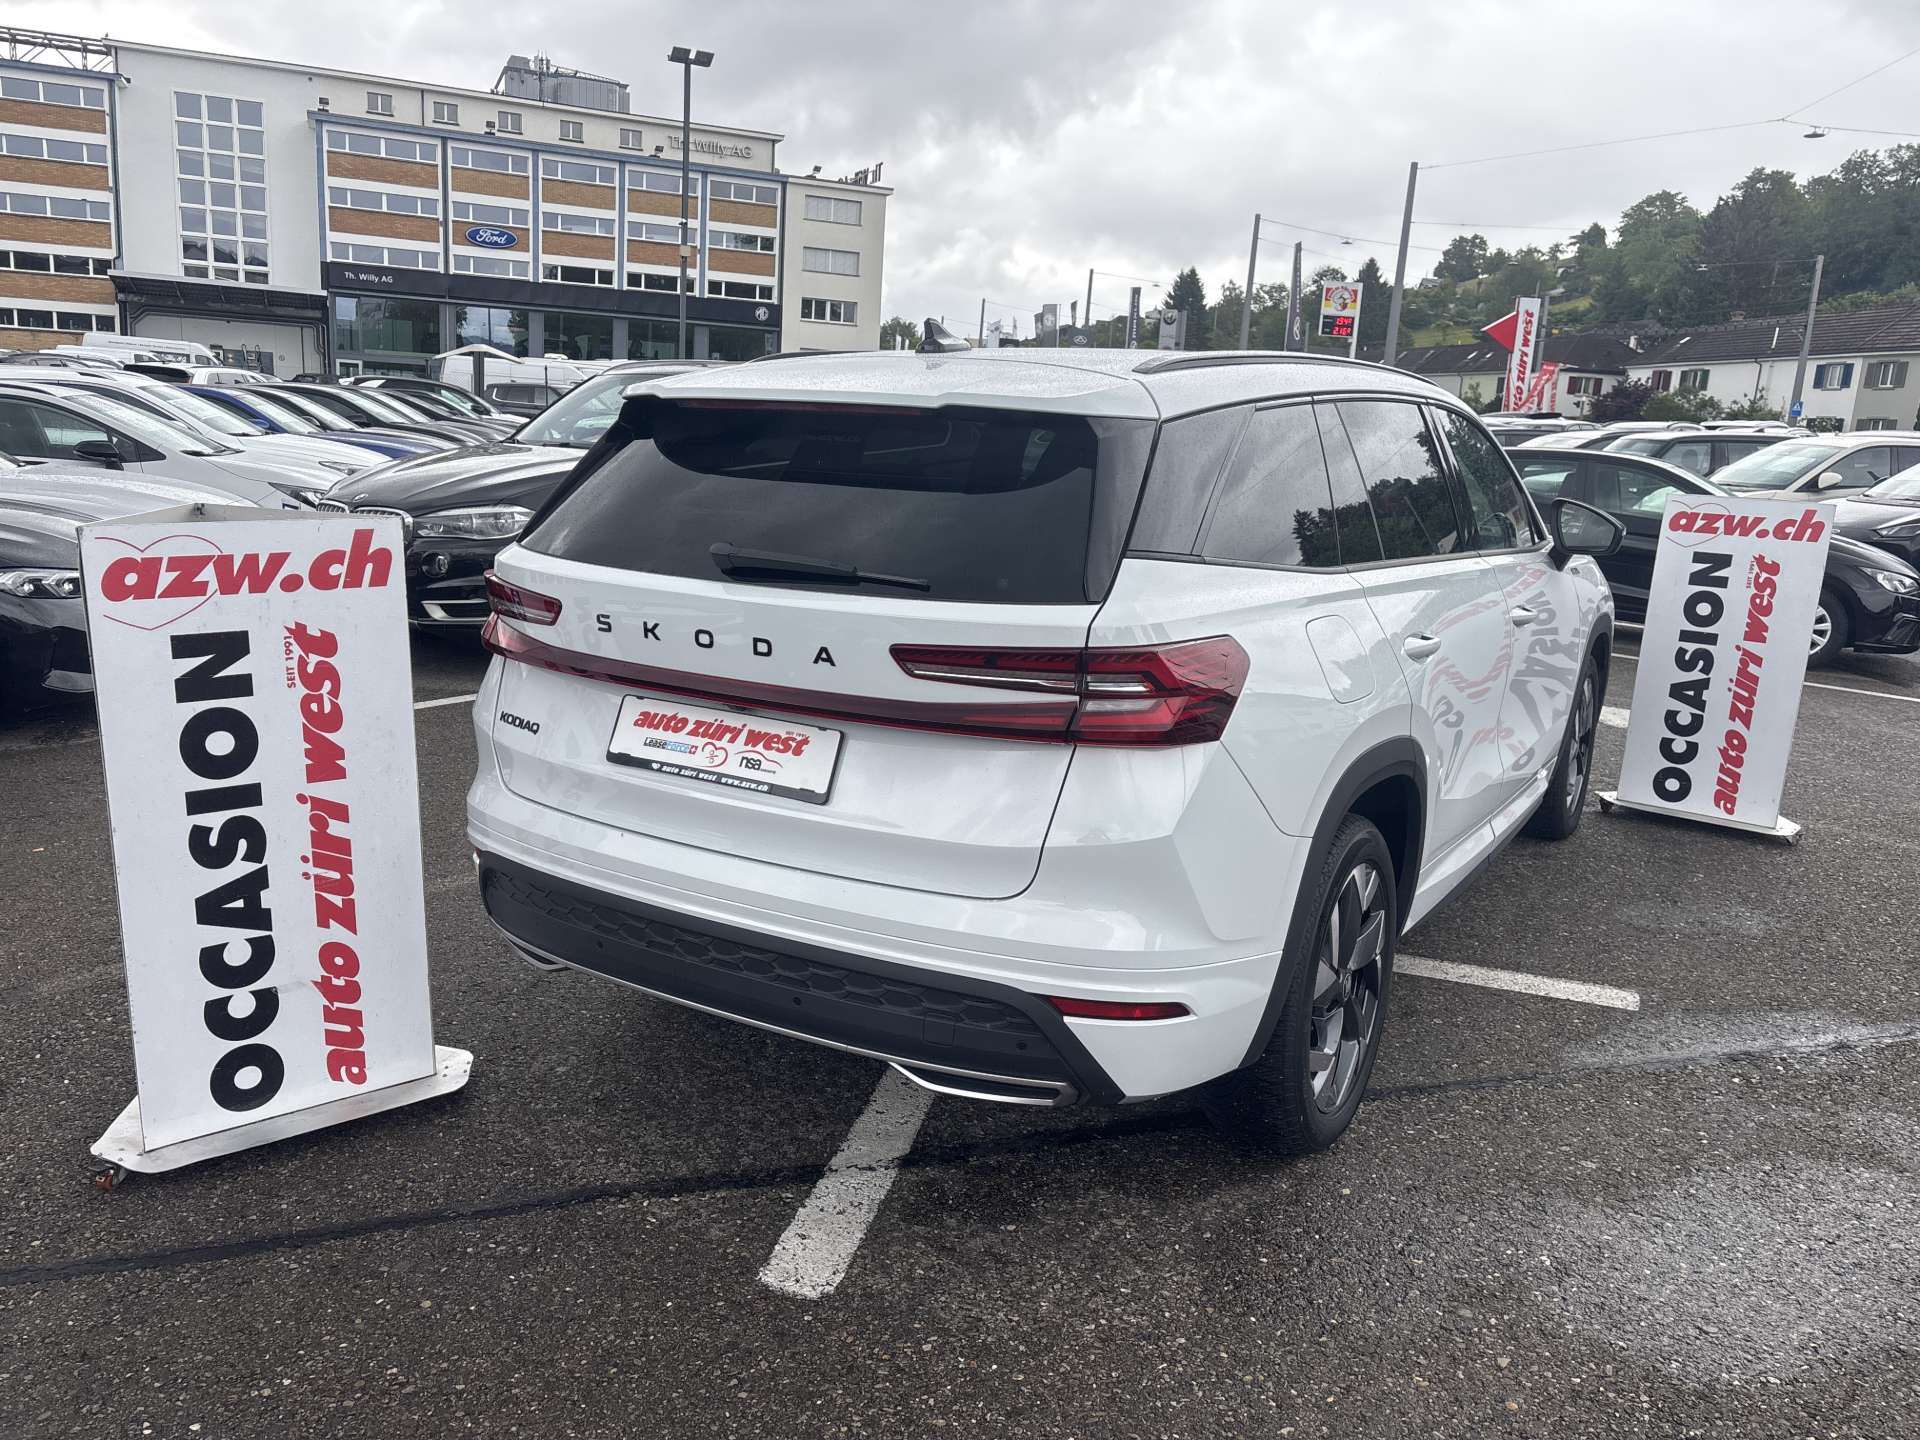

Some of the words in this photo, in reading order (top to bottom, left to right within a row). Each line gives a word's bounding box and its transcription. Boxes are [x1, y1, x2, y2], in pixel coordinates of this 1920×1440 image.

[695, 138, 726, 155] Willy
[731, 145, 753, 158] AG
[476, 228, 508, 244] Ford
[344, 271, 357, 280] Th.
[359, 272, 380, 283] Willy
[381, 275, 393, 283] AG
[1521, 309, 1535, 348] west
[1516, 349, 1529, 385] züri
[1668, 508, 1827, 543] azw.ch
[101, 529, 393, 602] azw.ch
[1744, 553, 1781, 644] west
[284, 635, 294, 661] 1991
[596, 613, 836, 667] SKODA
[286, 666, 297, 689] SEIT
[1653, 551, 1733, 803] OCCASION
[1727, 644, 1763, 730] züri
[283, 621, 348, 784] west
[499, 710, 540, 735] KODIAQ
[633, 711, 689, 733] auto
[686, 718, 748, 744] züri
[744, 728, 810, 757] west
[661, 765, 680, 775] auto
[698, 773, 718, 782] west
[721, 776, 769, 791] www.azw.ch
[739, 755, 762, 771] nsa
[1713, 729, 1748, 816] auto
[170, 629, 285, 1113] OCCASION
[295, 792, 358, 937] züri
[310, 941, 368, 1087] auto
